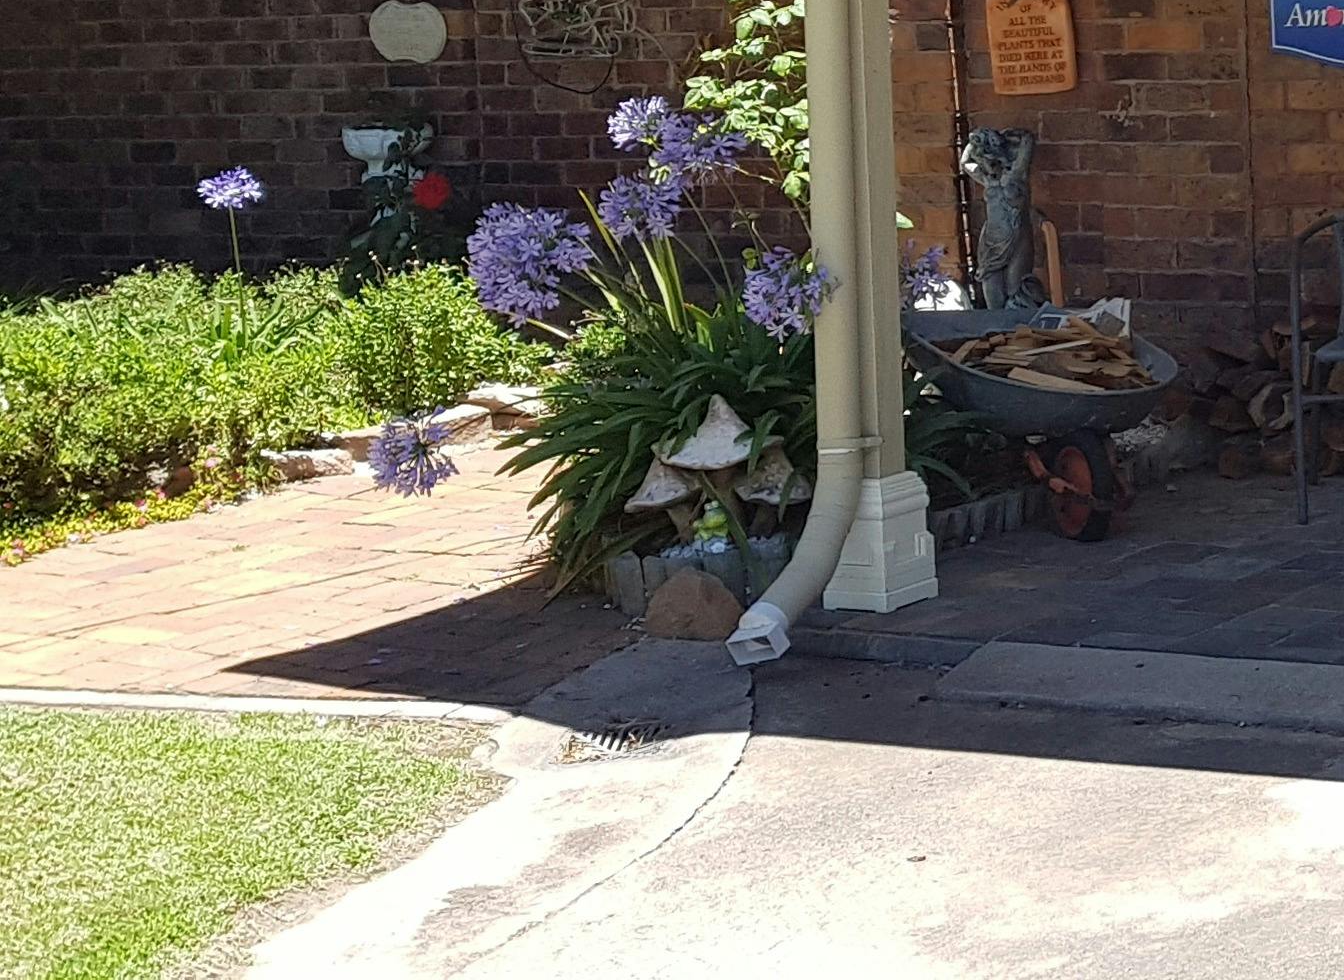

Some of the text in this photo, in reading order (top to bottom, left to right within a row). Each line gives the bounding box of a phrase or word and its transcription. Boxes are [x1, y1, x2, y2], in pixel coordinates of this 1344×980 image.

[1020, 4, 1031, 13] OF
[1008, 15, 1047, 26] ALL THE
[1002, 27, 1055, 38] BEAUTIFUL
[998, 38, 1061, 51] PLANTS THAT
[1000, 49, 1064, 63] DIED HERE AT
[997, 61, 1067, 75] THE HANDS OF
[1002, 74, 1066, 87] MY HUSBAND
